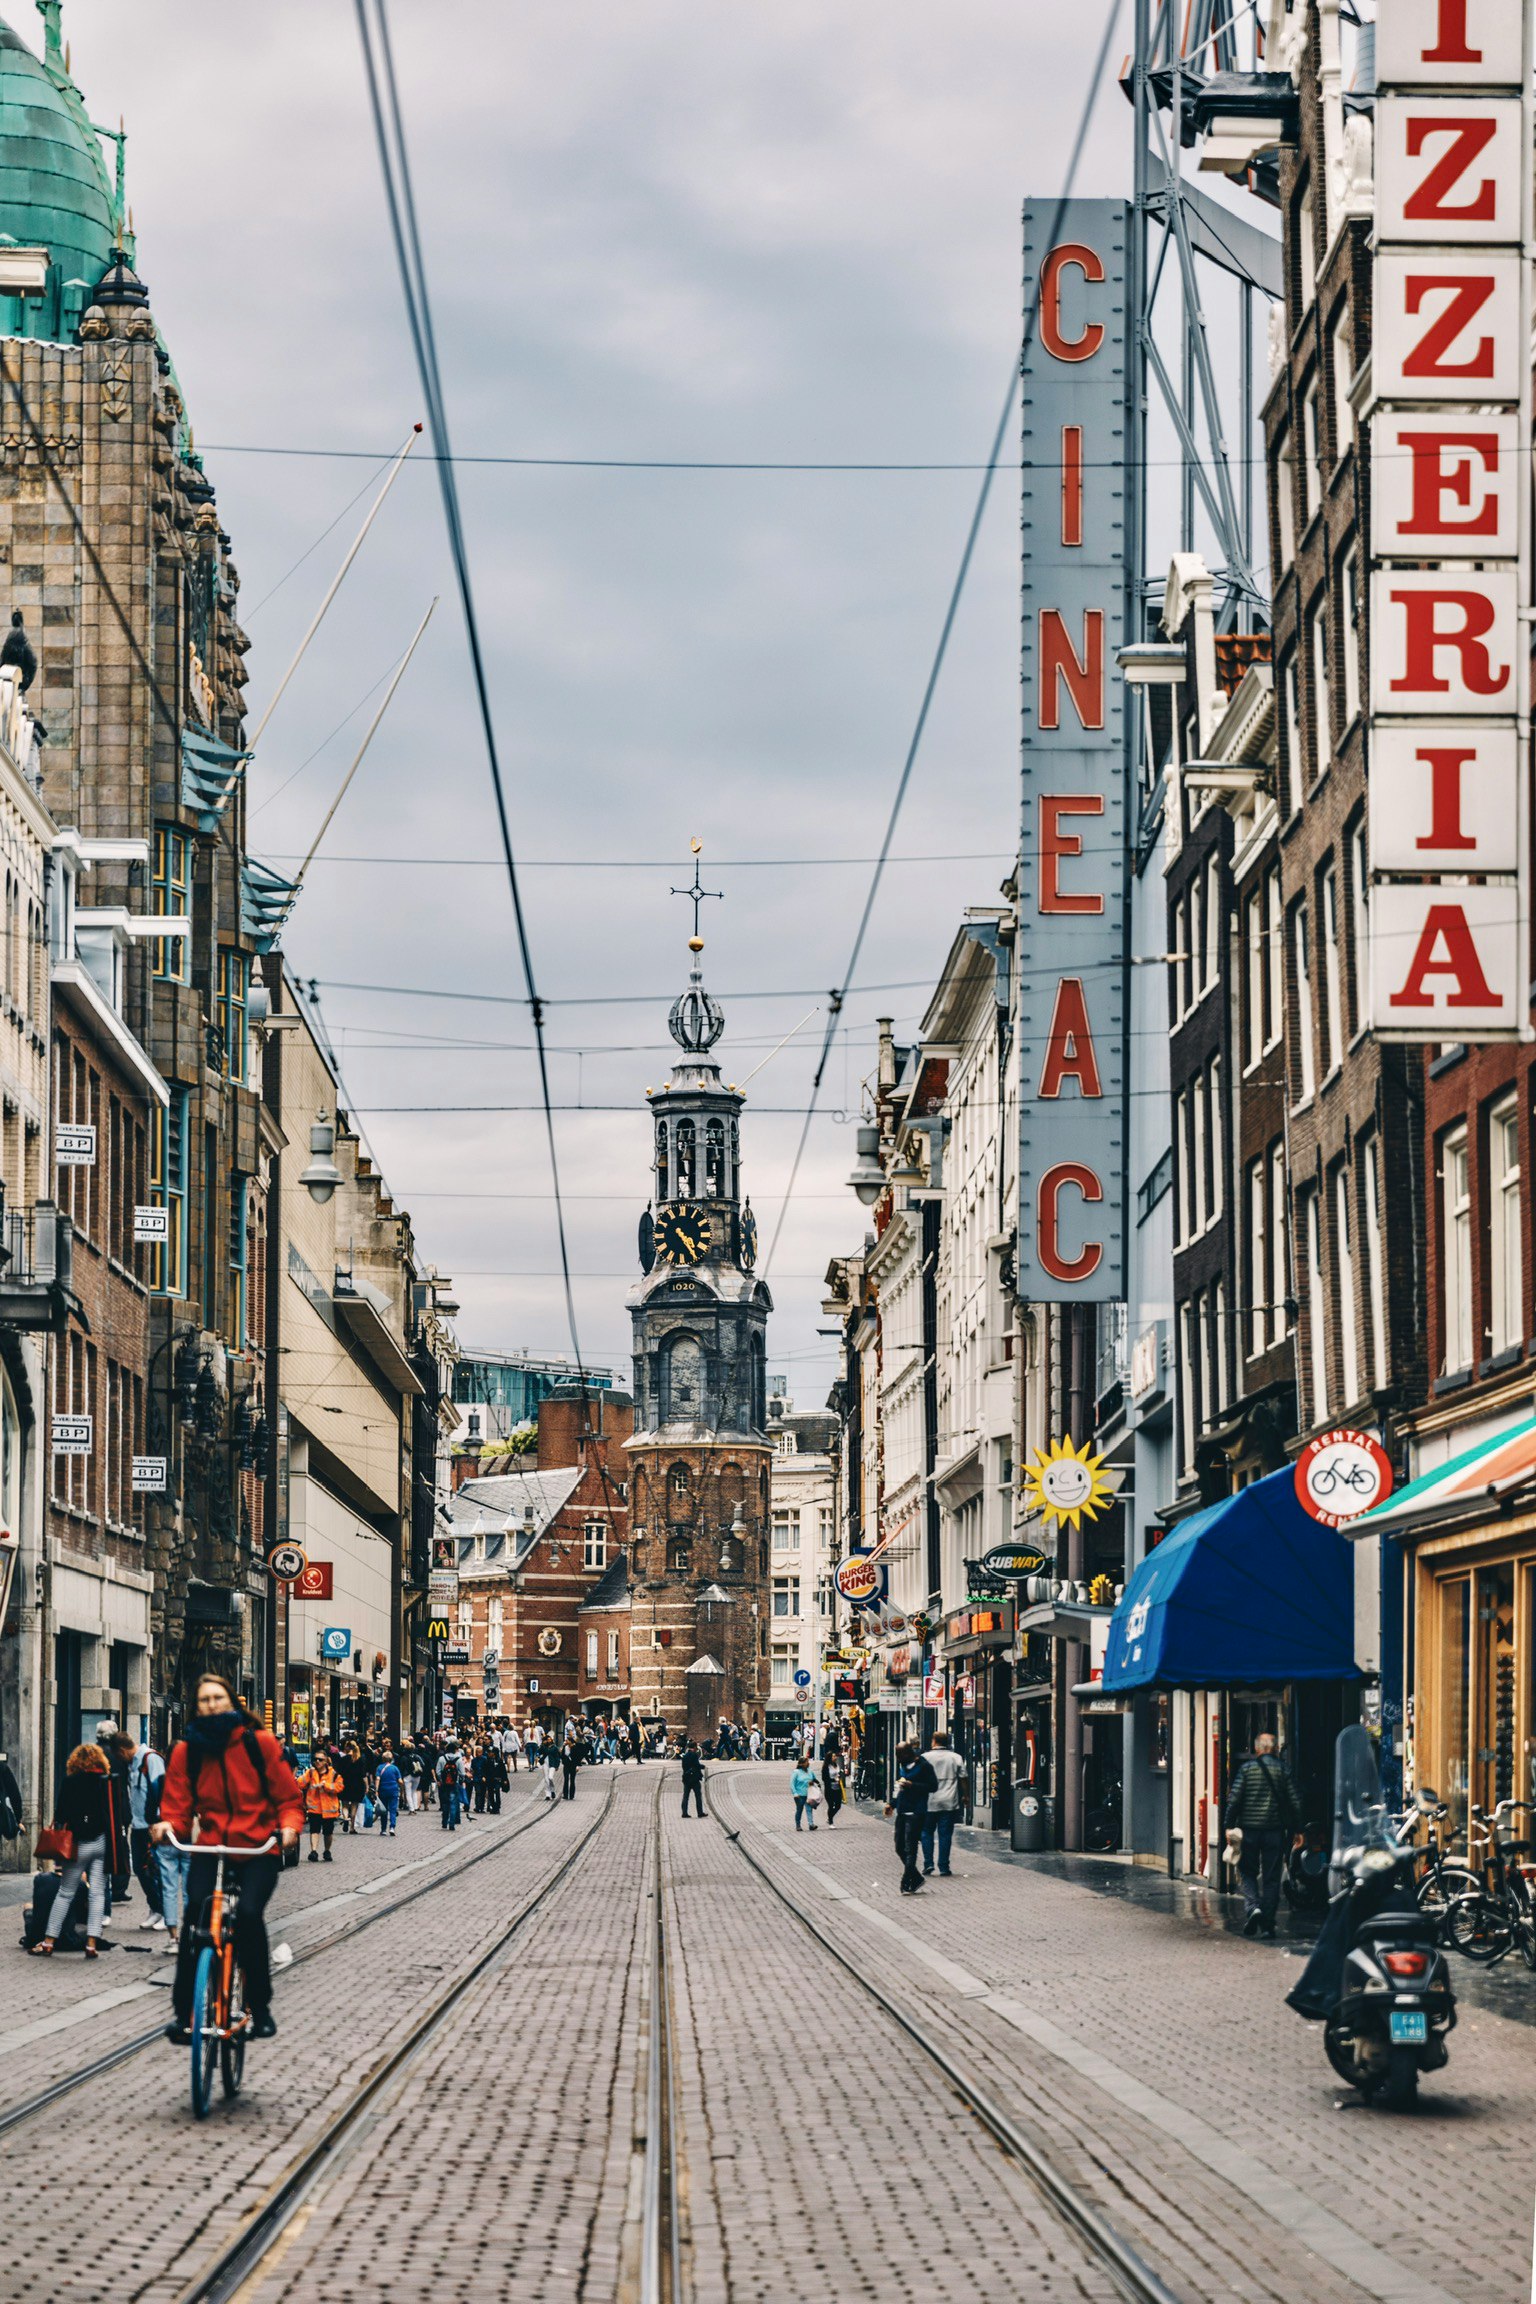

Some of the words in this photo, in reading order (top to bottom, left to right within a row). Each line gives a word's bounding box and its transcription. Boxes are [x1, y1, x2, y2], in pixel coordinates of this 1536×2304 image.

[1037, 243, 1105, 1282] CINEAC
[1310, 1431, 1374, 1454] RENTAL
[839, 1564, 875, 1581] BURGER
[986, 1556, 1045, 1569] SUBWAY
[840, 1572, 876, 1593] KING
